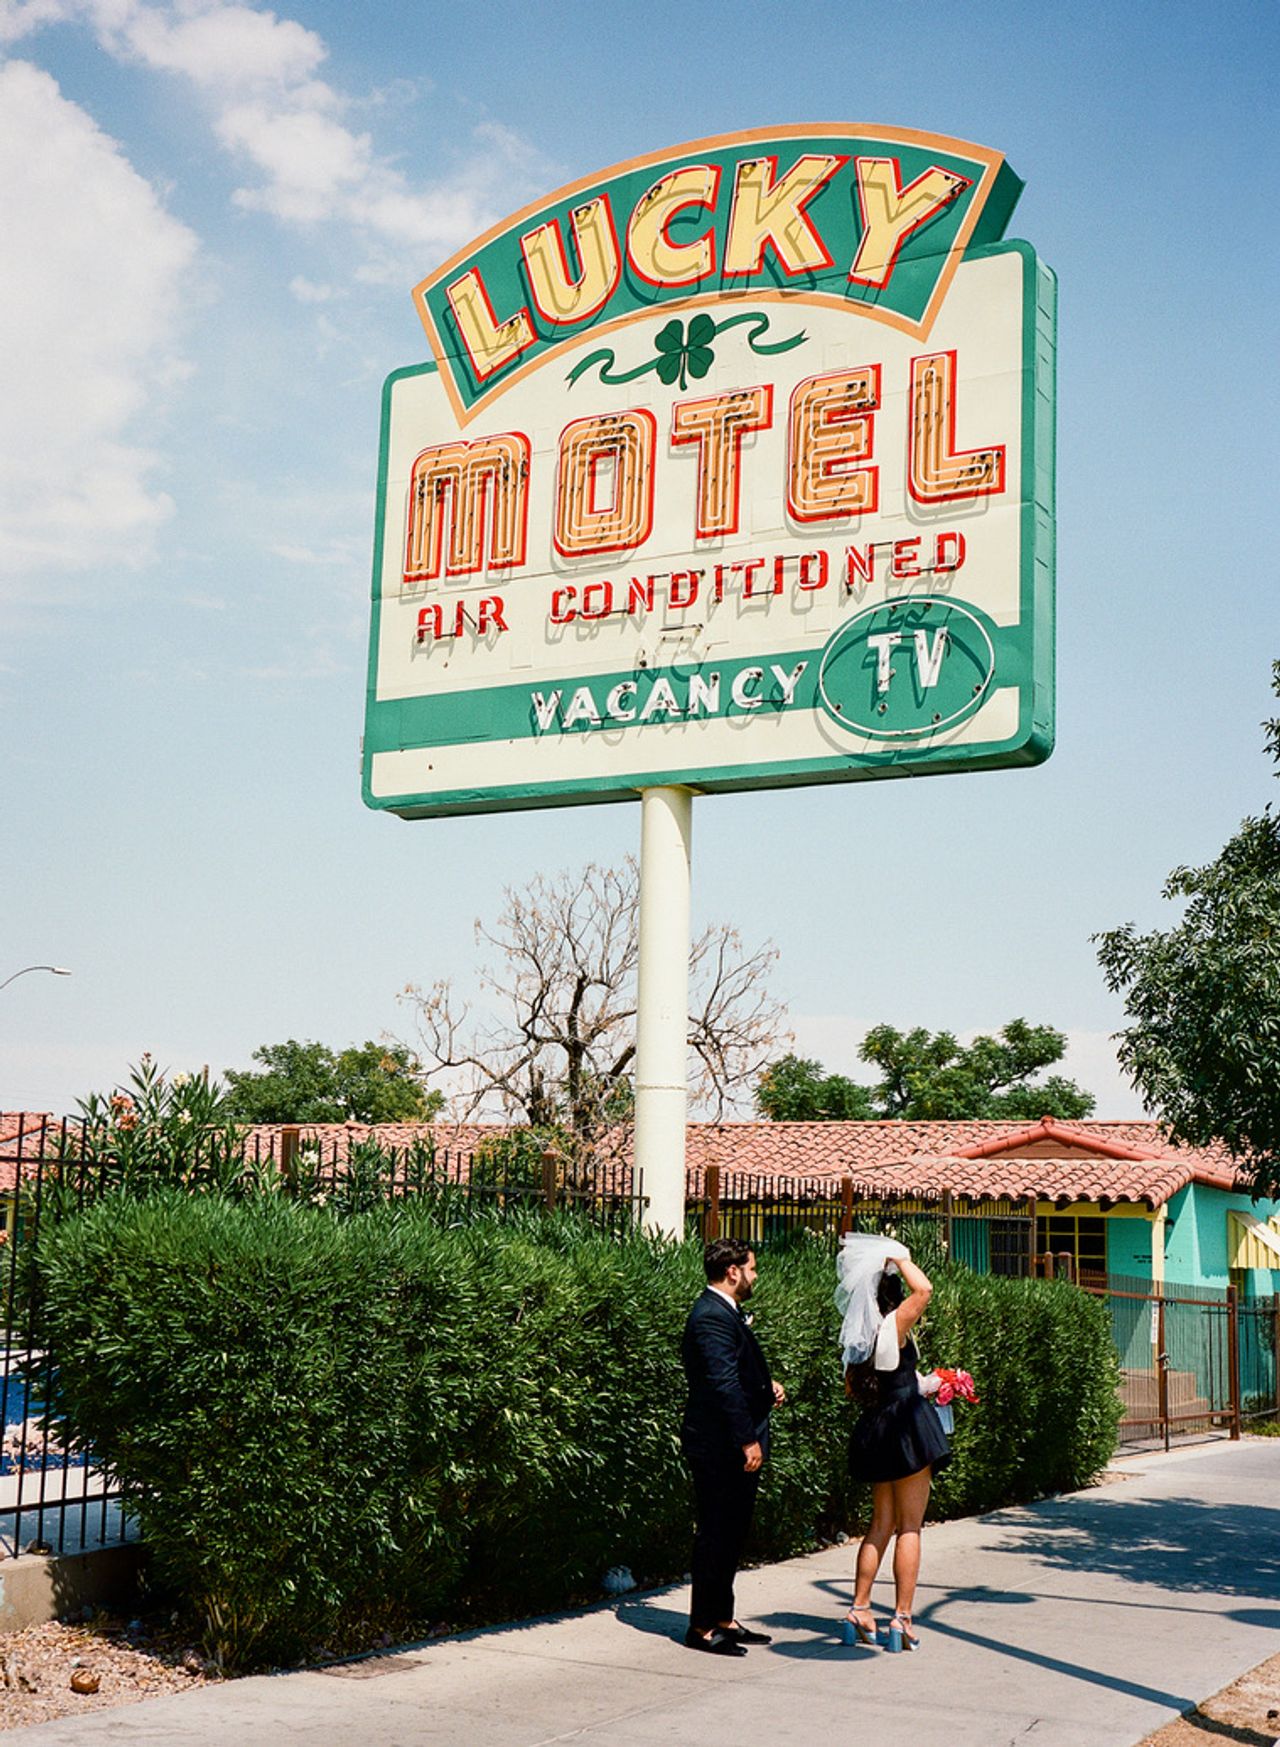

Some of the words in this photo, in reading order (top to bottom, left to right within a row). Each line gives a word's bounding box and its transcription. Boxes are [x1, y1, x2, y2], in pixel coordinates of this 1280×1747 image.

[445, 154, 974, 384] LUCKY
[402, 350, 1006, 583] MOTEL
[417, 595, 508, 640] AIR
[550, 532, 967, 624] CONDITIONED
[530, 661, 810, 731] VACANCY
[866, 626, 948, 692] TV
